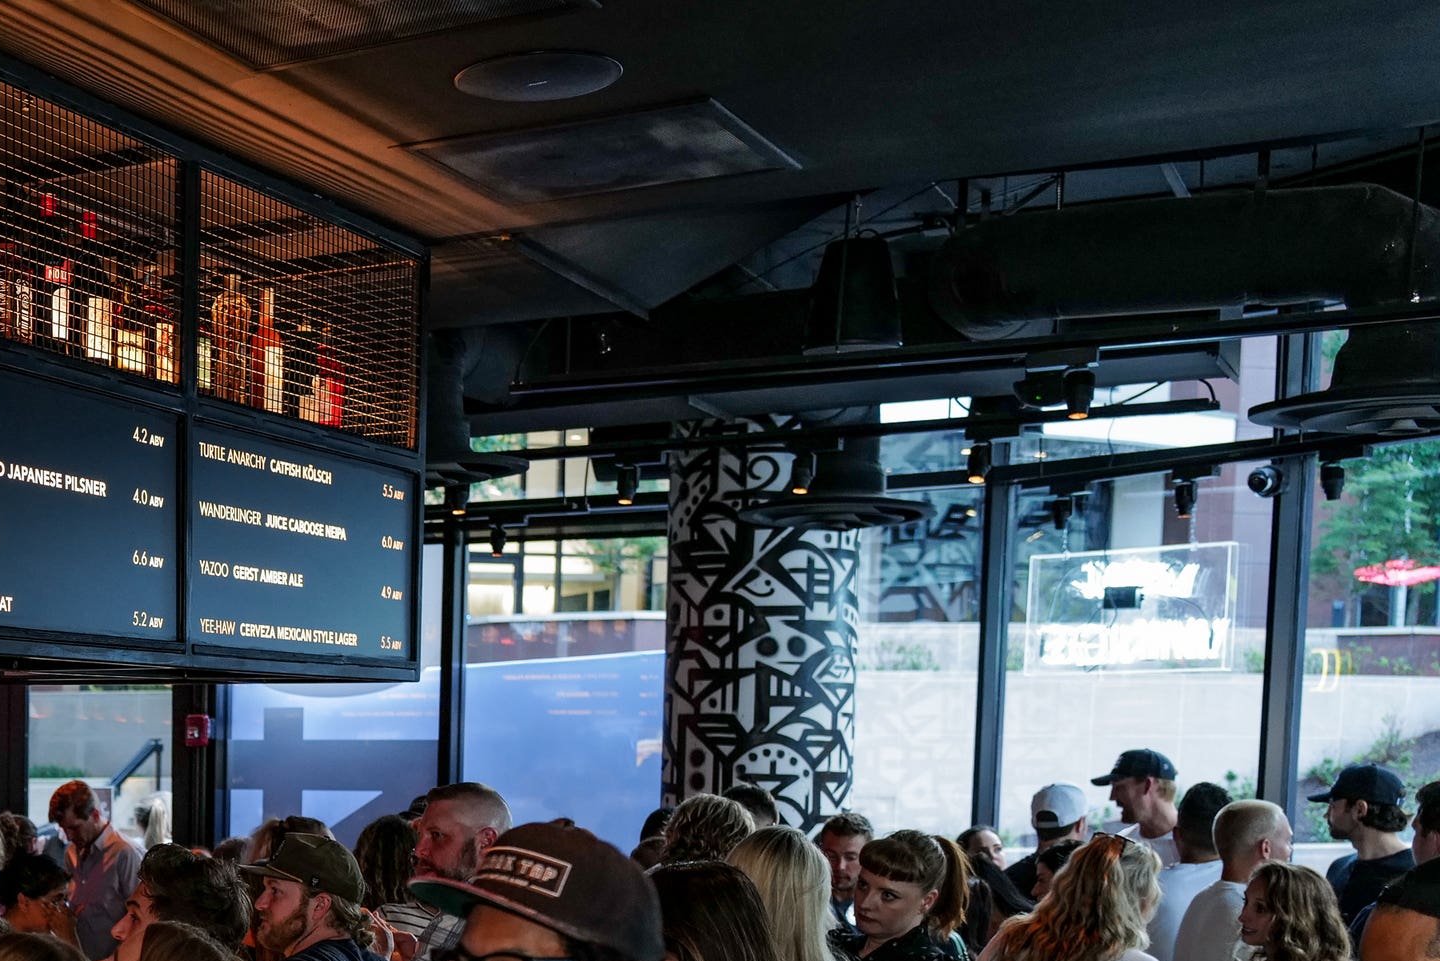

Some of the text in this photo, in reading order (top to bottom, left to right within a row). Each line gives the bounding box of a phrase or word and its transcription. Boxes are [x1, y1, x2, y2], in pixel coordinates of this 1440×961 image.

[133, 427, 147, 443] 4.2
[149, 435, 164, 447] ABV
[199, 442, 225, 461] TURTLE
[227, 449, 266, 470] ANARCHY
[270, 459, 301, 478] CATFISH
[7, 464, 62, 488] JAPANESE
[65, 475, 106, 497] PILSNER
[133, 488, 147, 505] 4.0
[149, 496, 164, 508] ABV
[265, 514, 287, 530] JUICE
[289, 518, 324, 536] CABOOSE
[133, 550, 147, 566] 6.6
[149, 556, 164, 568] ABV
[200, 560, 229, 577] YAZOO
[233, 565, 259, 581] GERST
[260, 569, 287, 585] AMBER
[289, 573, 303, 587] ALE
[133, 611, 147, 627] 5.2
[149, 617, 163, 628] ABV
[240, 623, 276, 639] CERVEZA
[277, 626, 312, 642] MEXICAN
[313, 630, 334, 644] STYLE
[335, 632, 357, 646] LAGER
